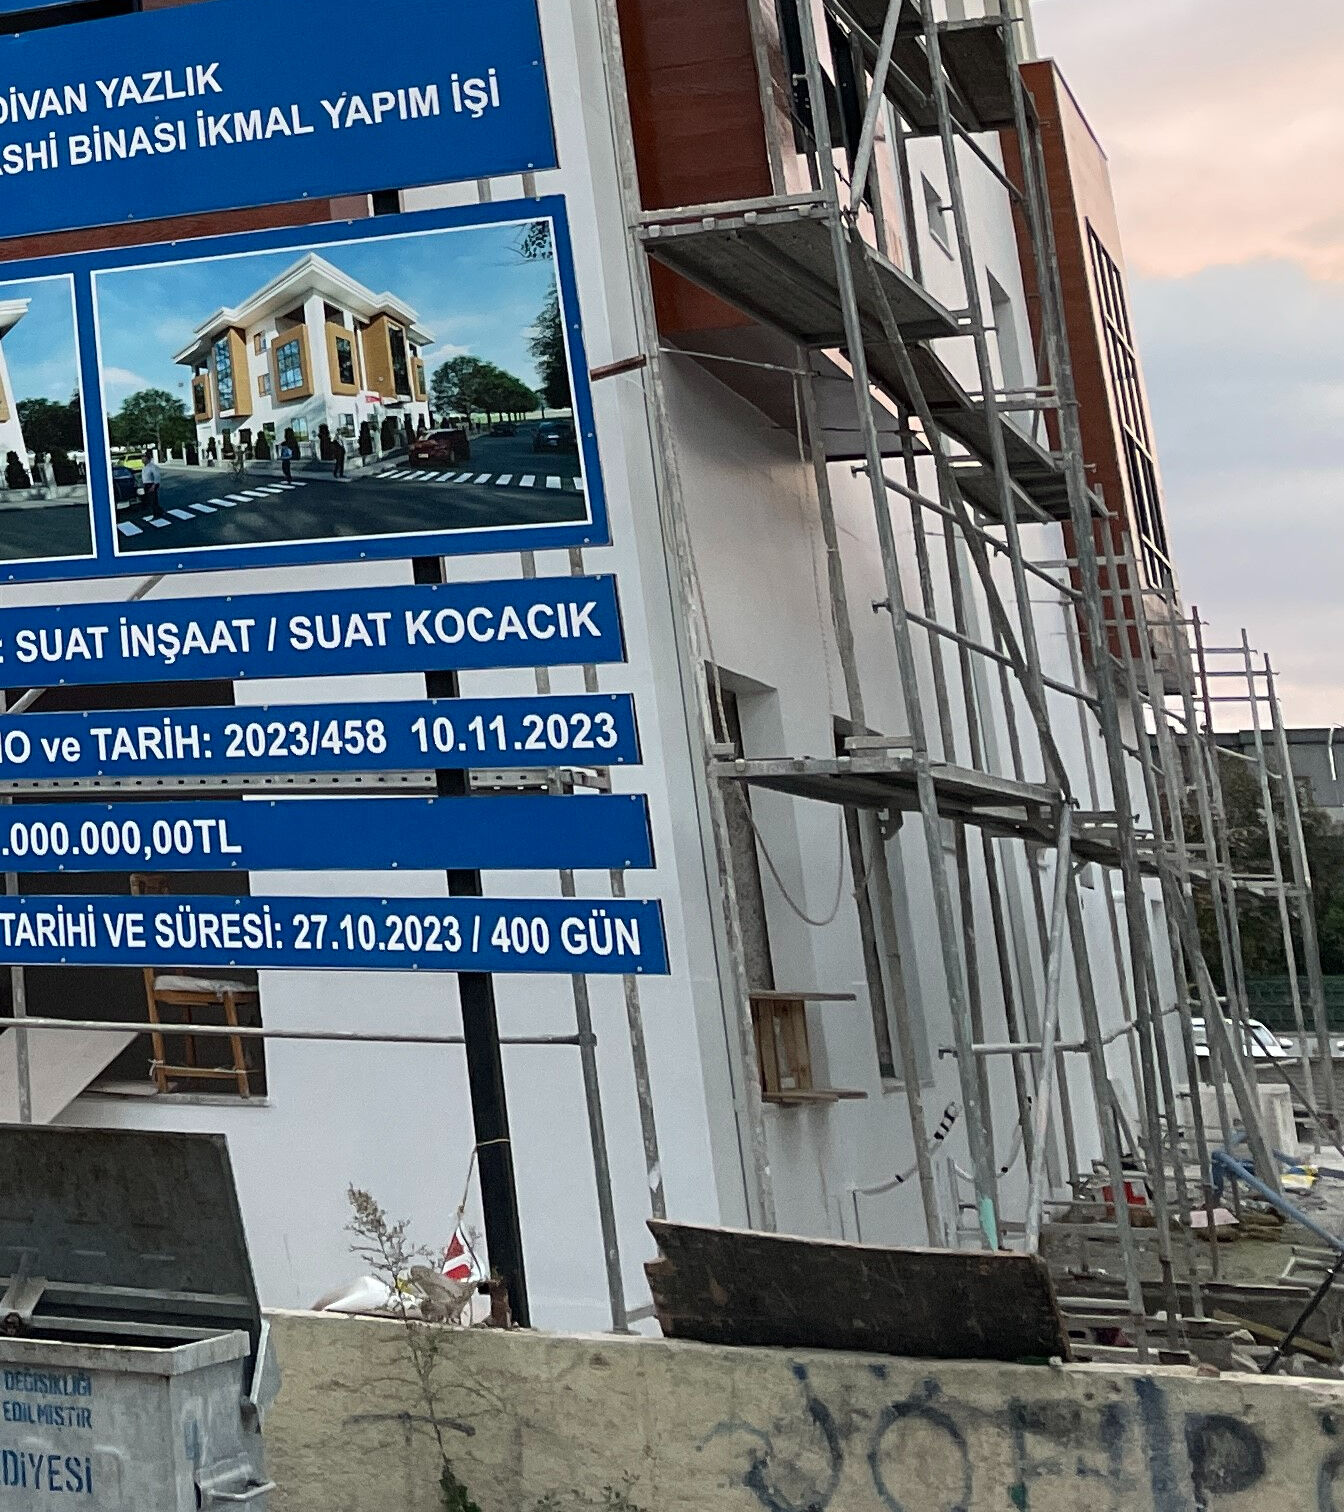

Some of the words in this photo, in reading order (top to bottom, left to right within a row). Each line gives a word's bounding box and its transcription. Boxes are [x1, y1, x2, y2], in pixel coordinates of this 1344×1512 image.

[95, 62, 223, 109] YAZLIK
[68, 120, 187, 166] BİNASI
[196, 104, 314, 148] İKMAL
[320, 84, 440, 129] YAPIM
[450, 68, 500, 118] İŞİ
[16, 626, 109, 663] SUAT
[119, 617, 256, 665] İNŞAAT
[267, 617, 277, 652] /
[289, 612, 392, 650] SUAT
[405, 601, 602, 645] KOCACIK
[40, 737, 81, 762] ve
[89, 717, 212, 761] TARİH:
[224, 718, 387, 758] 2023/458
[411, 712, 618, 752] 10.11.2023
[102, 913, 147, 948] VE
[154, 904, 283, 949] SÜRESİ:
[292, 913, 462, 952] 27.10.2023
[472, 915, 480, 953] /
[491, 916, 550, 954] 400
[560, 909, 641, 956] GÜN
